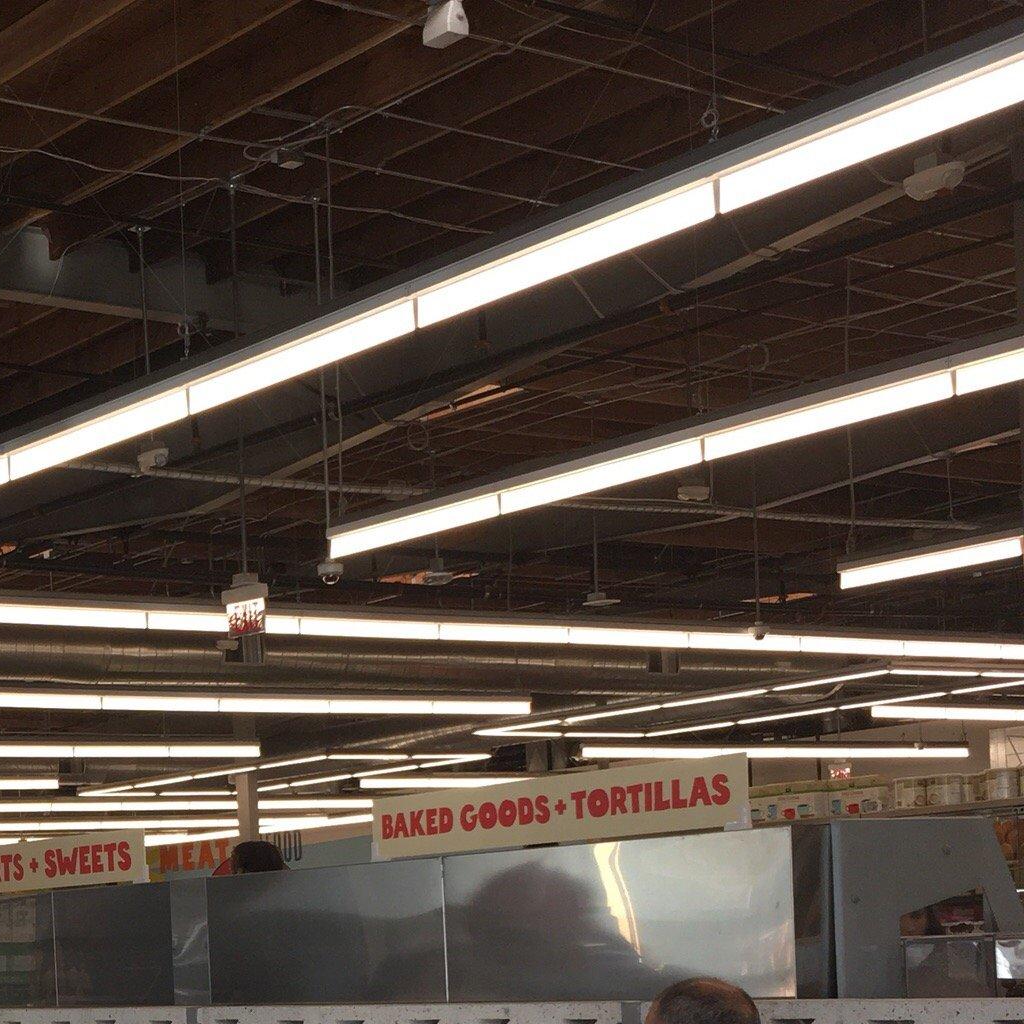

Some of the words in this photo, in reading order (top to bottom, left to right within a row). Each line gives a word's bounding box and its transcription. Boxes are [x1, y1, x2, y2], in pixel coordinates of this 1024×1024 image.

[381, 806, 454, 840] BAKED
[459, 795, 550, 832] GOODS
[555, 799, 567, 816] +
[570, 773, 732, 820] TORTILLAS
[29, 857, 39, 873] +
[44, 841, 132, 879] SWEETS
[159, 839, 229, 873] MEAT
